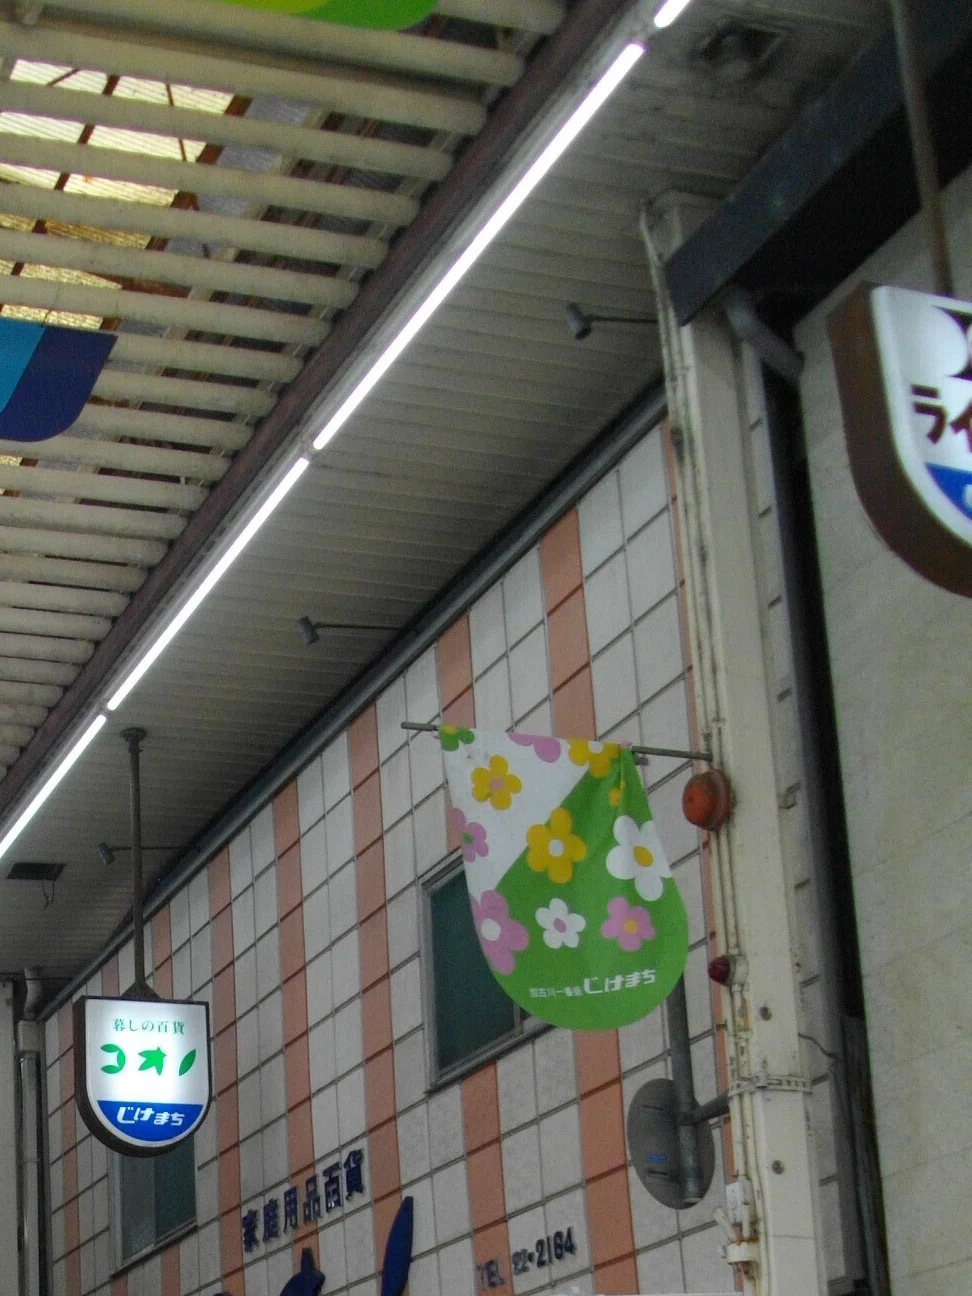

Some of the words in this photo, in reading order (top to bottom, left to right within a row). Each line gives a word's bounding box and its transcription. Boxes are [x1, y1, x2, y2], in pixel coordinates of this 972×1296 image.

[583, 968, 657, 994] じけまち
[112, 1018, 185, 1035] 暮しの百貨
[100, 1043, 197, 1077] コオノ
[116, 1105, 185, 1127] じけまち
